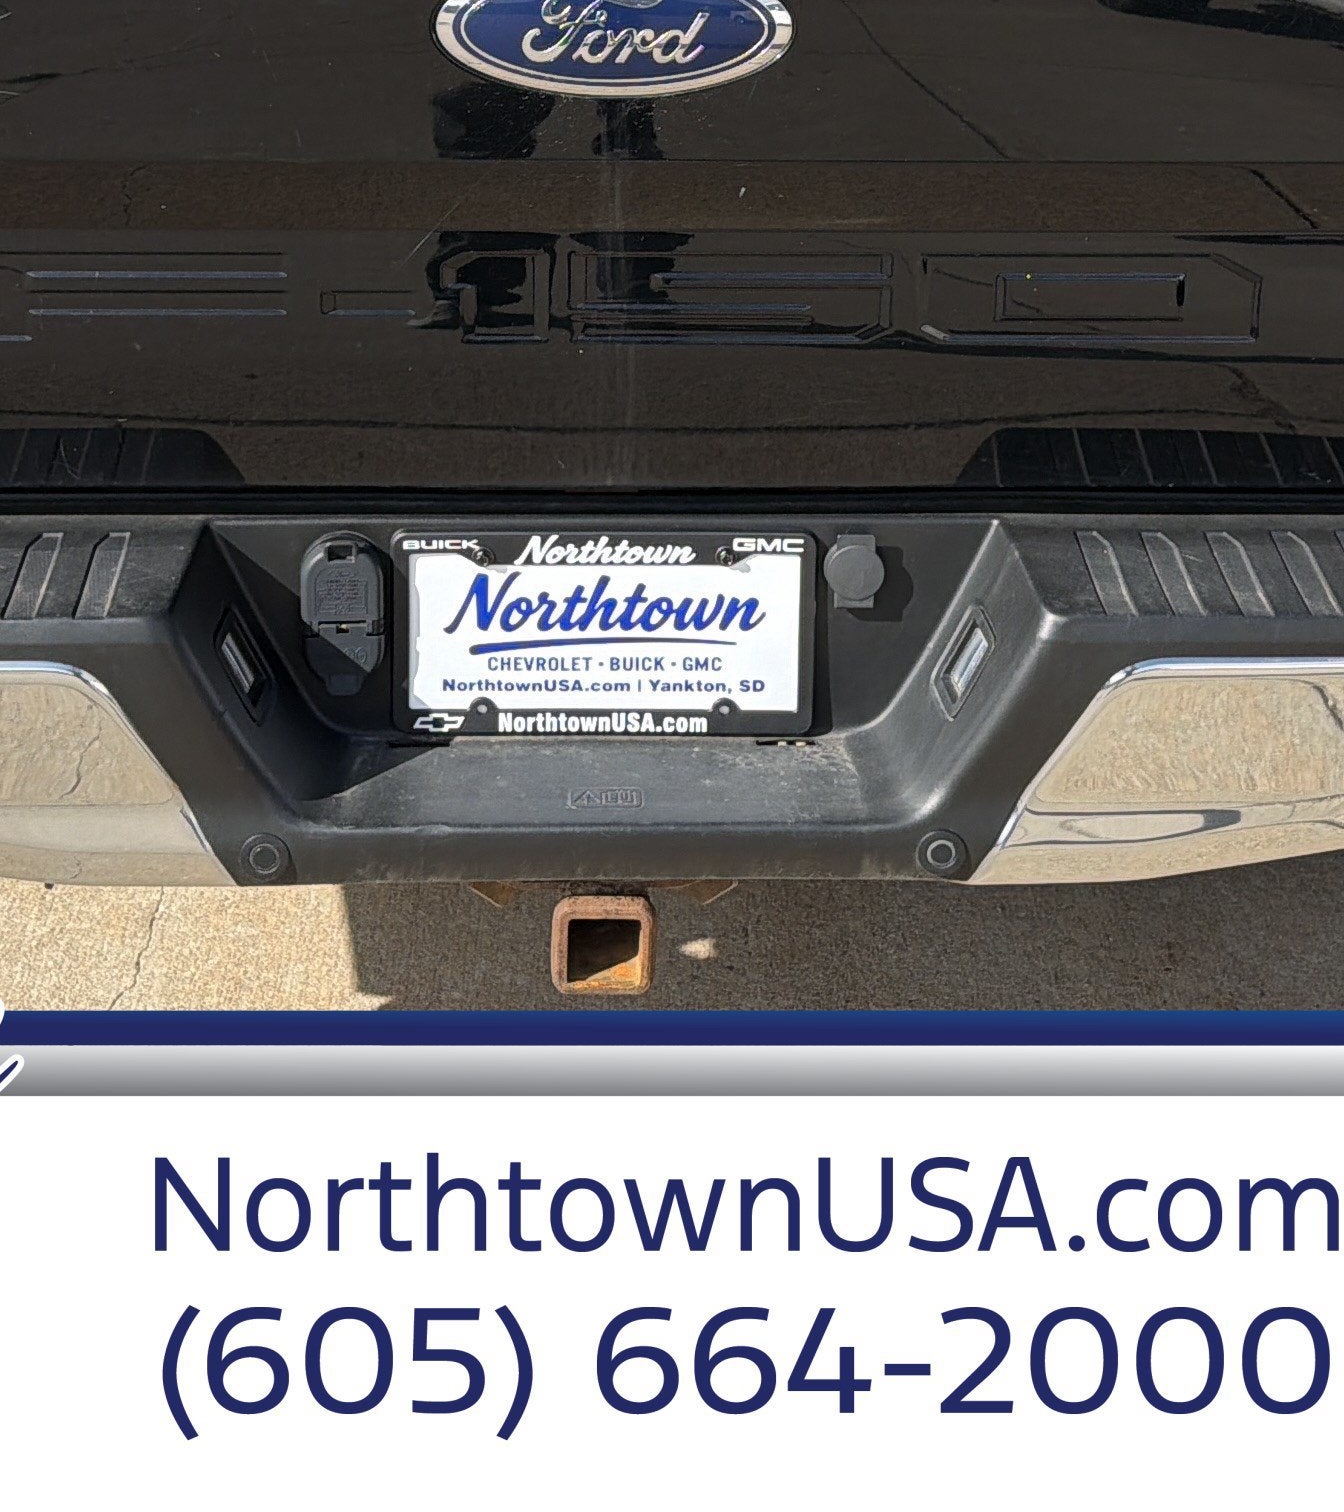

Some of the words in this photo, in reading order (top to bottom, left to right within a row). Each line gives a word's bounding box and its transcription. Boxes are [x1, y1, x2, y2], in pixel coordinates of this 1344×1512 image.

[403, 539, 479, 550] BUICK
[514, 534, 696, 566] Northtown
[733, 538, 805, 552] GMC
[443, 571, 766, 634] Northtown
[487, 656, 593, 672] CHEVROLET
[609, 656, 665, 672] BUICK
[682, 656, 723, 672] GMC
[442, 678, 631, 693] NorthtownUSA.com
[649, 678, 733, 695] Yankton,
[739, 679, 766, 693] SD
[498, 712, 708, 734] NorthtownUSA.com
